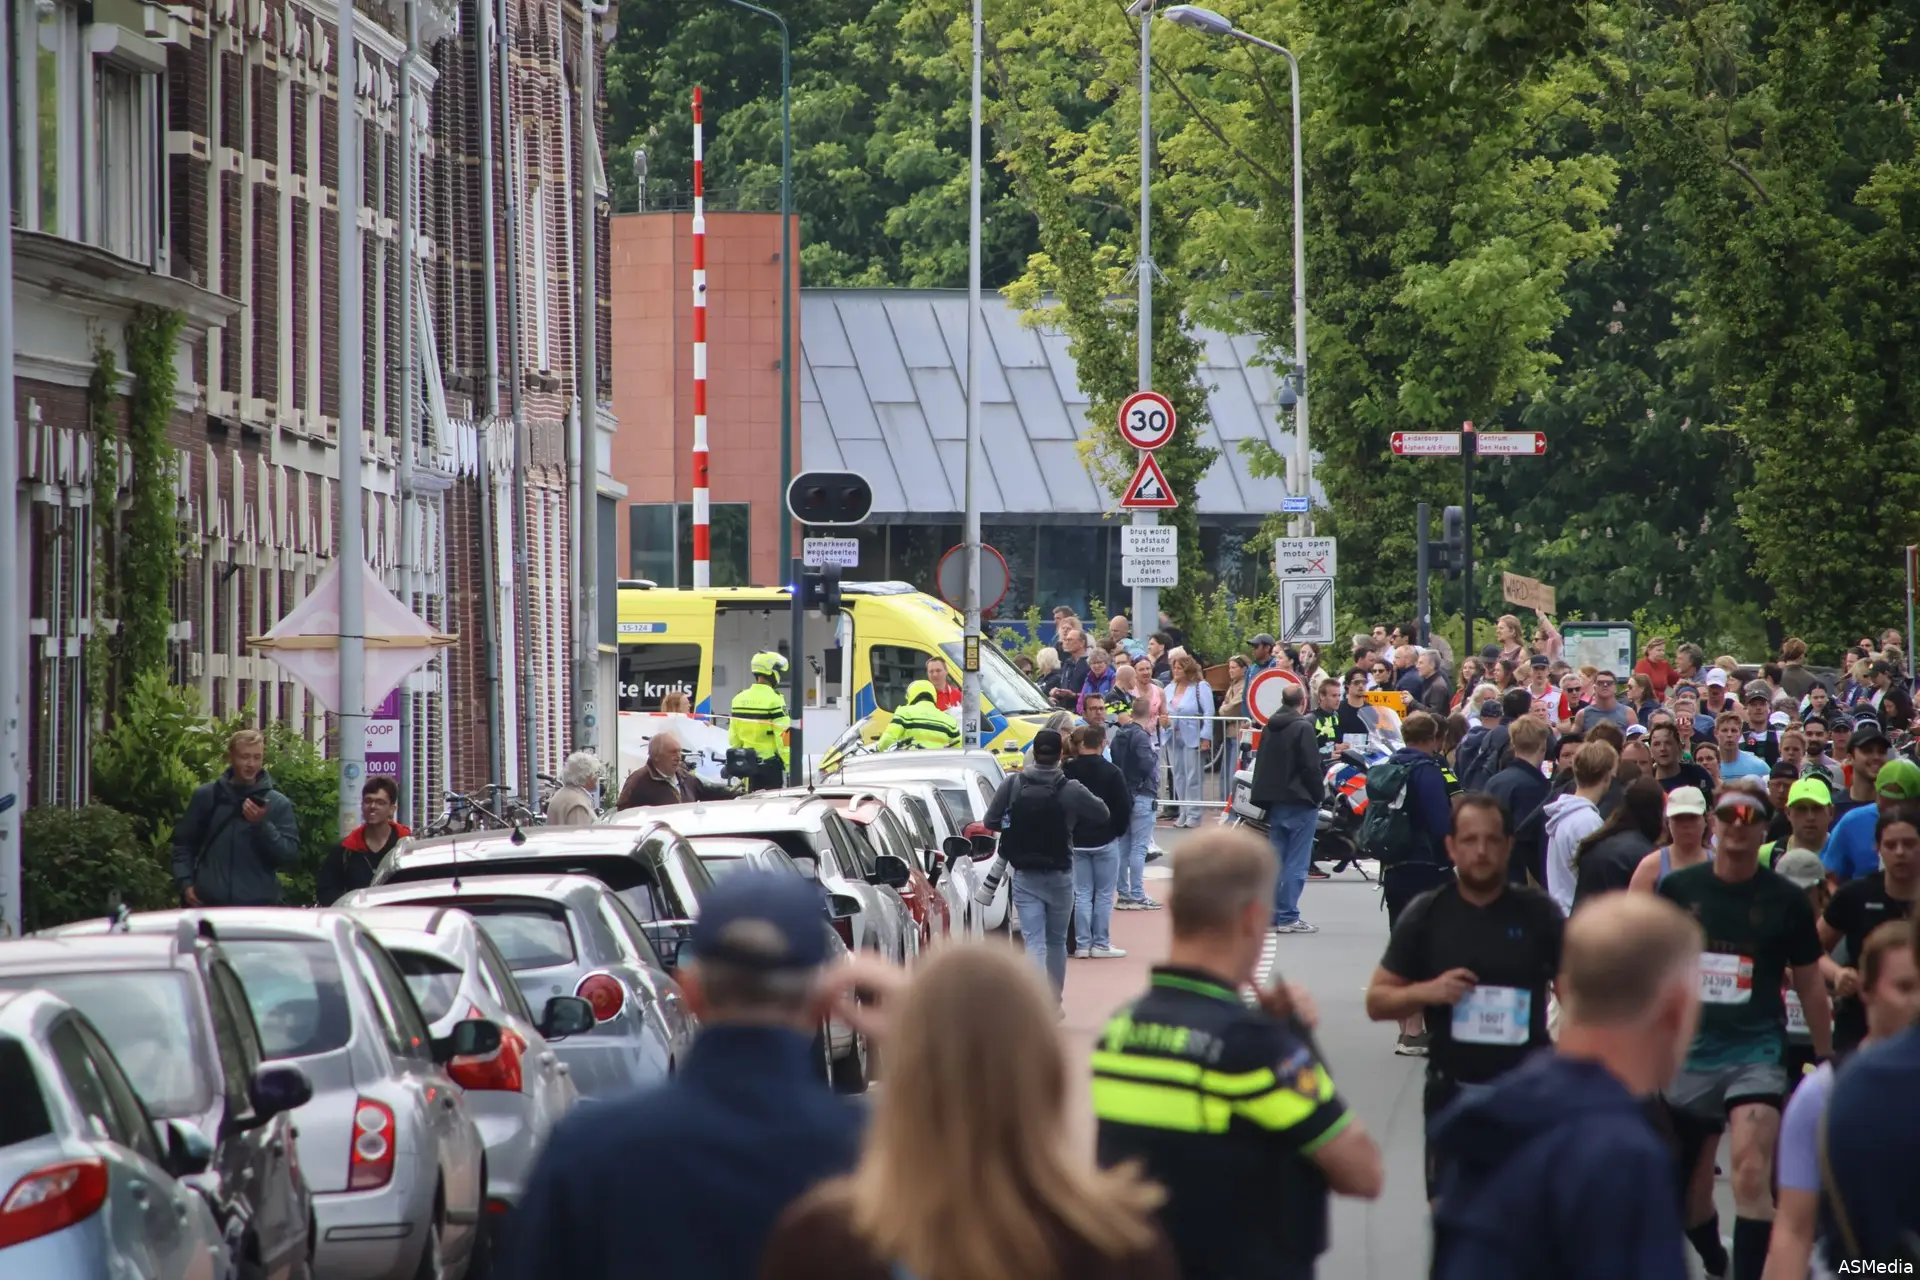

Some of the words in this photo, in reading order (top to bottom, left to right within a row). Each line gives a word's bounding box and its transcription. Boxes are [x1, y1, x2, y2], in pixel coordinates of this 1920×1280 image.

[1130, 410, 1166, 432] 30
[1130, 528, 1147, 536] brug
[807, 541, 857, 549] gemarkeerde
[1282, 541, 1303, 549] brug
[1308, 540, 1330, 548] open
[807, 549, 857, 557] weggedeelten
[1316, 549, 1329, 557] uit
[1130, 559, 1171, 567] slagbomen
[644, 680, 692, 698] kruis
